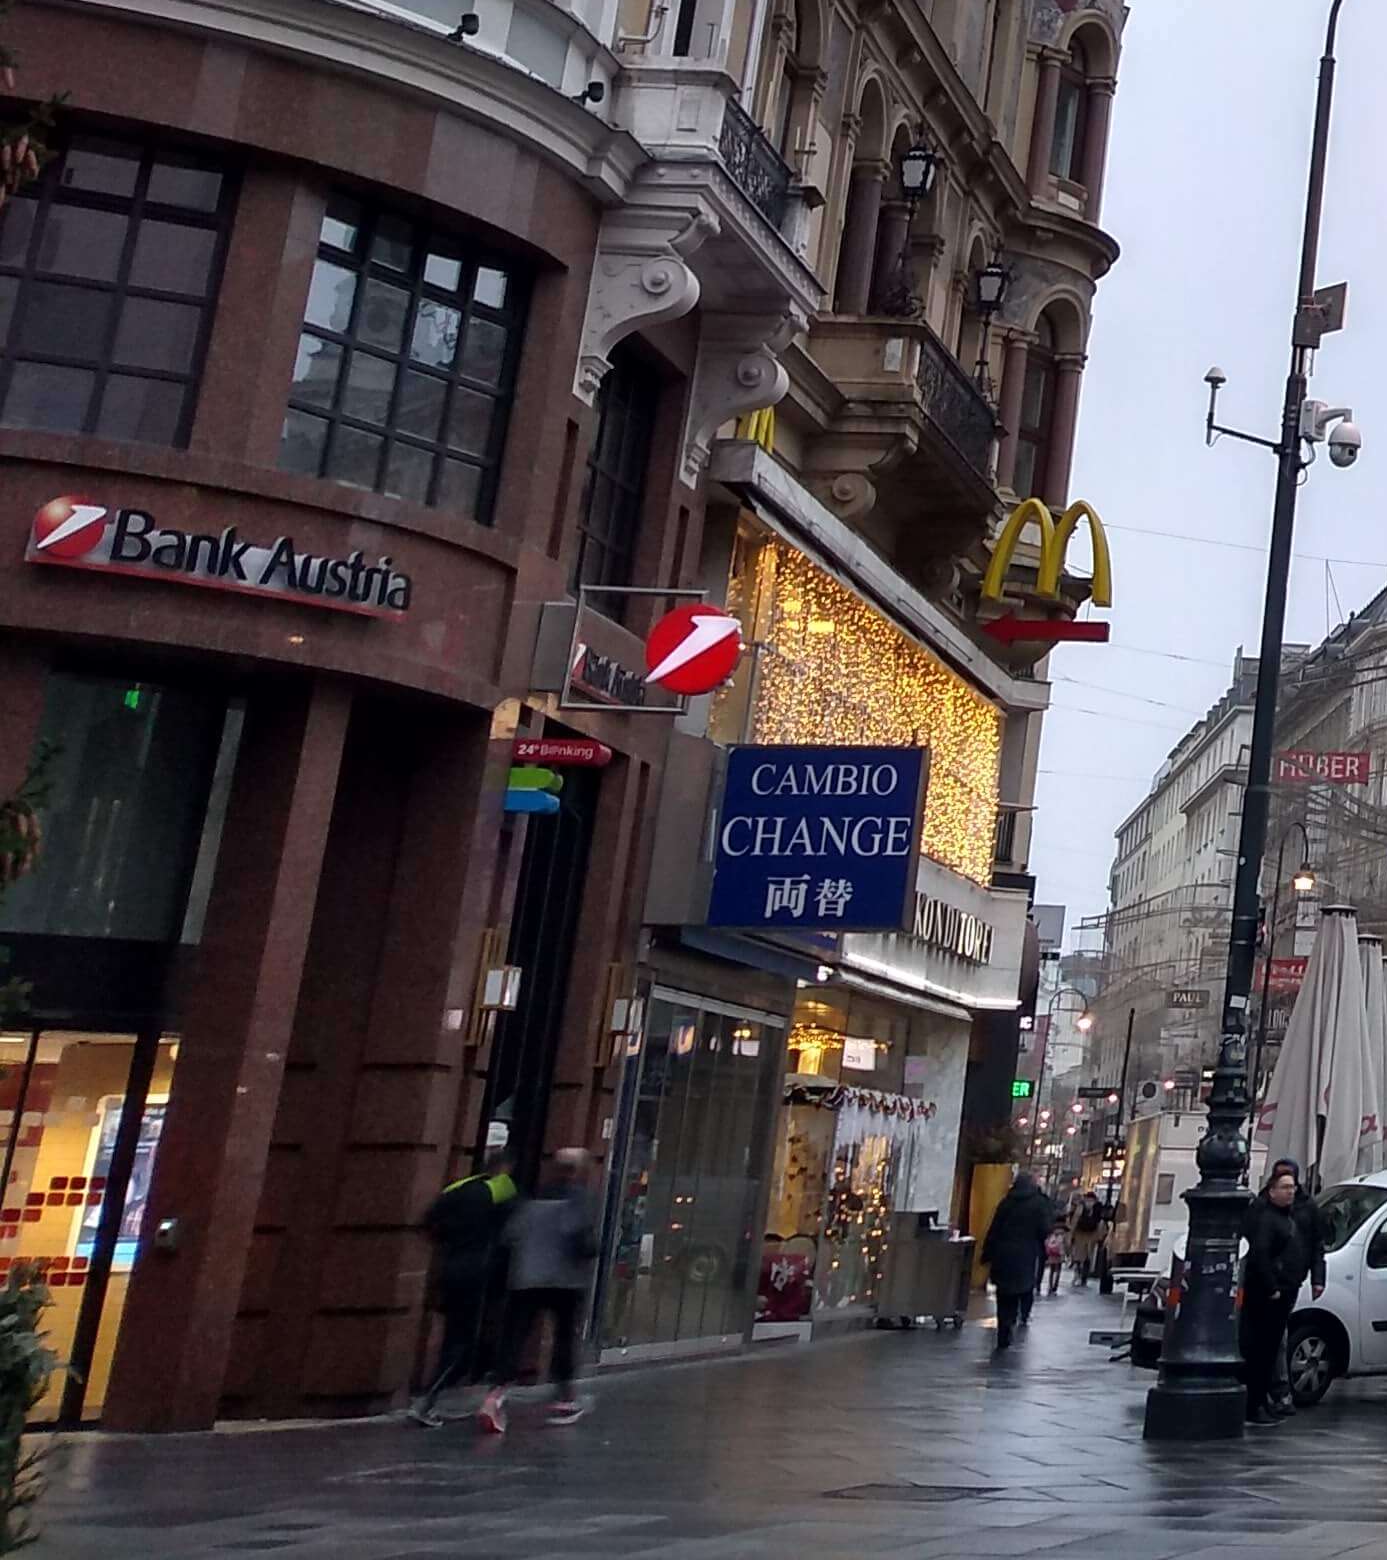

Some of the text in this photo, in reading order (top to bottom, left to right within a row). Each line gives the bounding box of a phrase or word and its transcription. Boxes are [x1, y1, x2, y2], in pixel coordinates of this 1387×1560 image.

[110, 508, 413, 611] Bank Austria
[751, 763, 898, 796] CAMBIO
[721, 816, 912, 857] CHANGE
[763, 873, 854, 919] 両替
[913, 891, 993, 966] KONDITOREI
